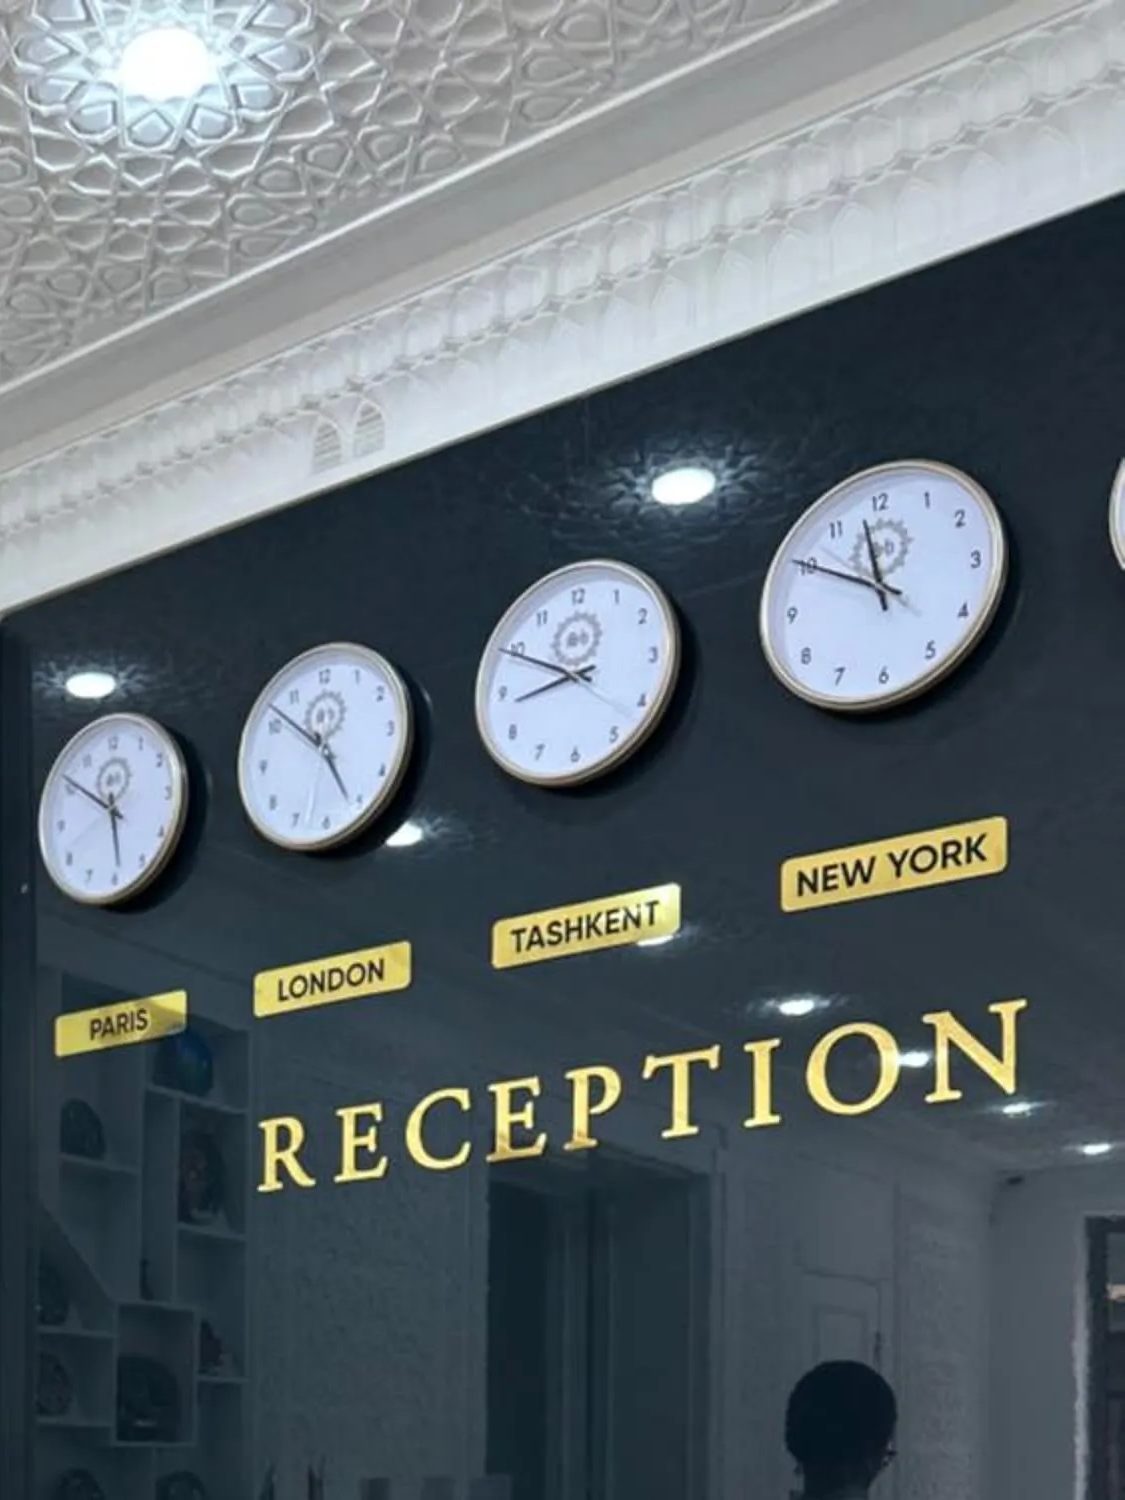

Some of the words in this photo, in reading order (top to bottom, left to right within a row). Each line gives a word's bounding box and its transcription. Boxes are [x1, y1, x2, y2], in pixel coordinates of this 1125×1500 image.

[872, 493, 890, 511] 12
[923, 492, 930, 508] 1
[954, 510, 966, 528] 2
[829, 521, 843, 538] 11
[970, 550, 981, 569] 3
[571, 588, 585, 605] 12
[614, 589, 620, 605] 1
[536, 610, 548, 626] 11
[638, 608, 648, 625] 2
[787, 607, 798, 624] 9
[957, 602, 968, 618] 4
[650, 647, 659, 663] 3
[801, 647, 812, 665] 8
[924, 640, 936, 660] 5
[834, 667, 845, 686] 7
[878, 666, 890, 684] 6
[498, 686, 508, 701] 9
[637, 693, 646, 707] 4
[508, 724, 517, 740] 8
[609, 726, 619, 743] 5
[535, 744, 546, 760] 7
[571, 746, 580, 762] 6
[797, 856, 876, 897] NEW
[888, 832, 988, 879] YORK
[510, 900, 661, 953] TASHKENT
[278, 958, 385, 1003] LONDON
[89, 1008, 149, 1041] PARIS
[257, 998, 1028, 1193] RECEPTION
